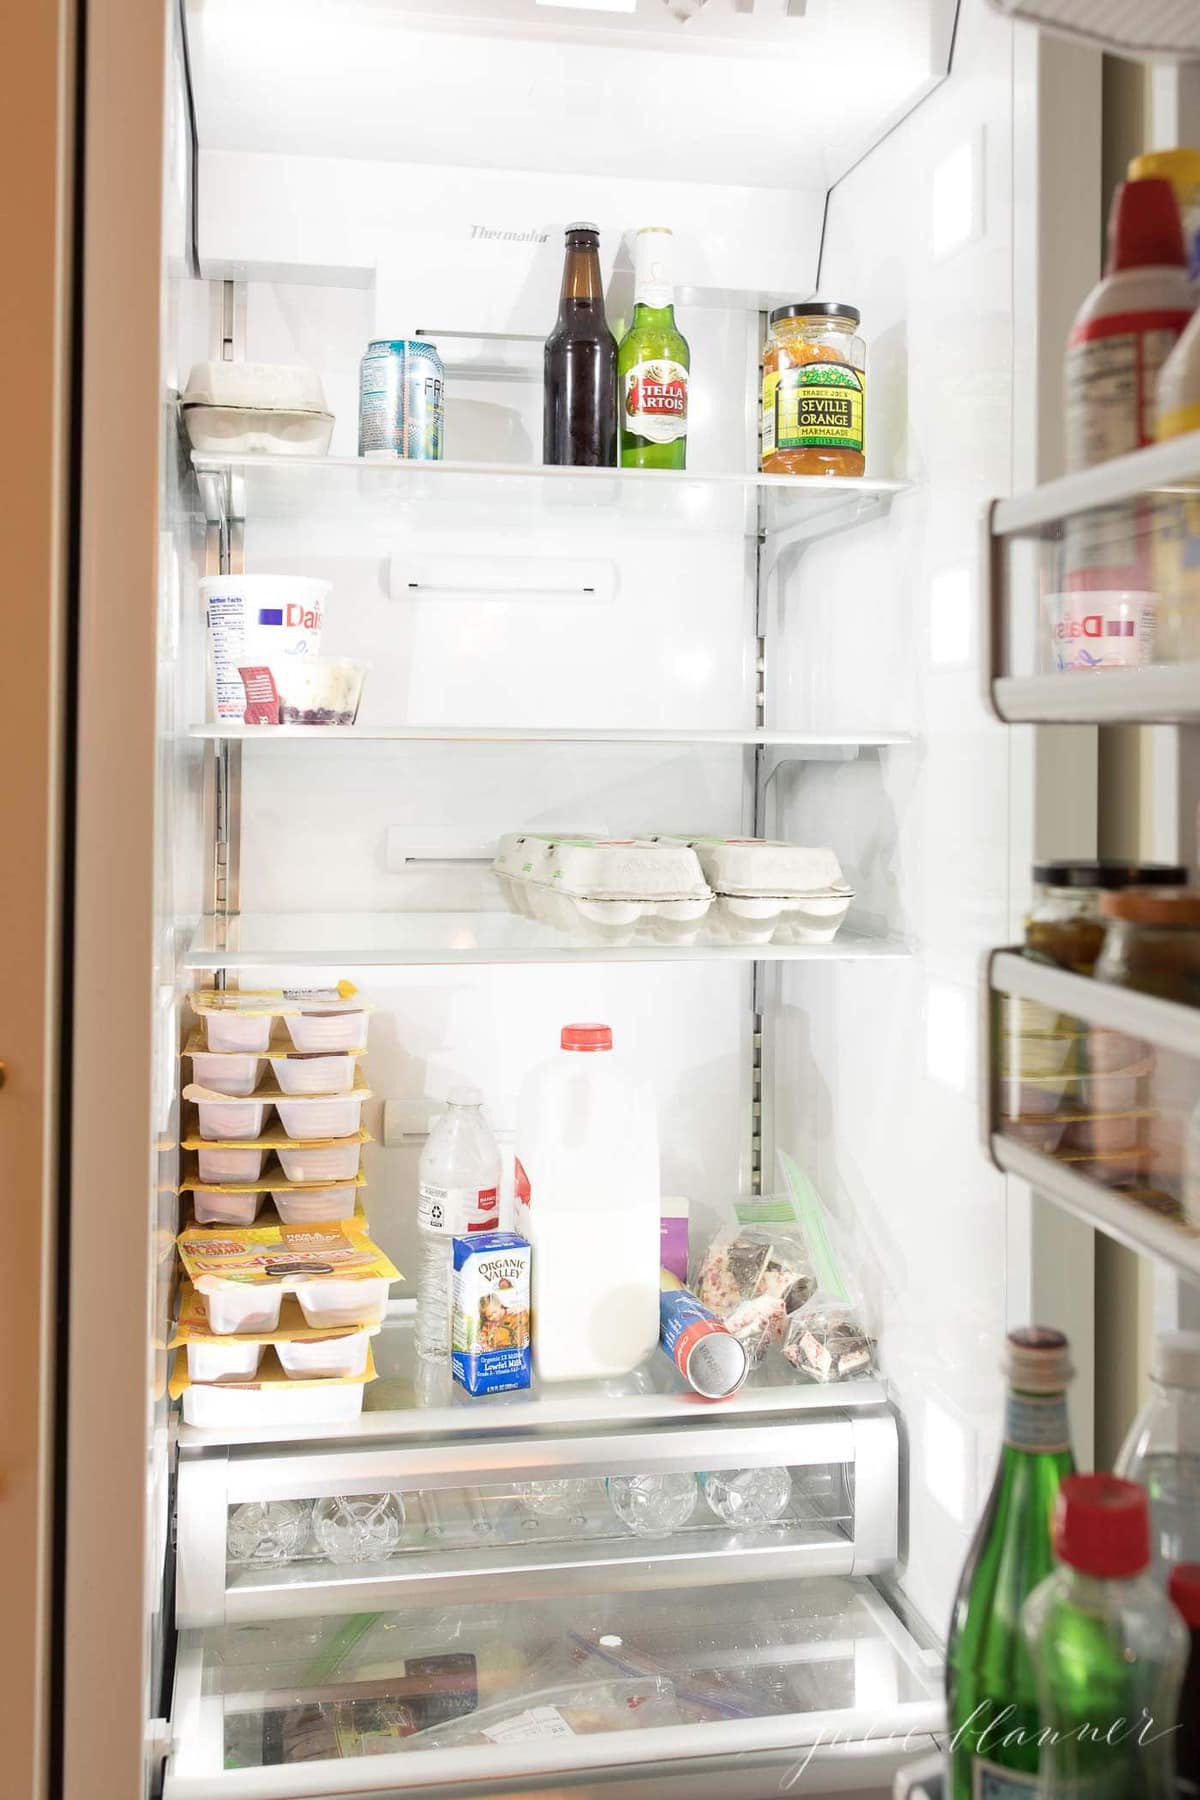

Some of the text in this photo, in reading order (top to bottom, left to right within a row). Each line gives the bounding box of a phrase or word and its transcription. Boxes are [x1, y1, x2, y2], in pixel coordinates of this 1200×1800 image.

[471, 224, 551, 243] Thermador
[639, 385, 683, 398] STELLA
[637, 397, 684, 410] ARTOIS
[801, 400, 848, 412] SEVILLE
[801, 414, 848, 426] ORANGE
[801, 428, 848, 436] MARMALADE
[478, 1258, 526, 1275] ORGANIC
[484, 1268, 520, 1282] VALLEY
